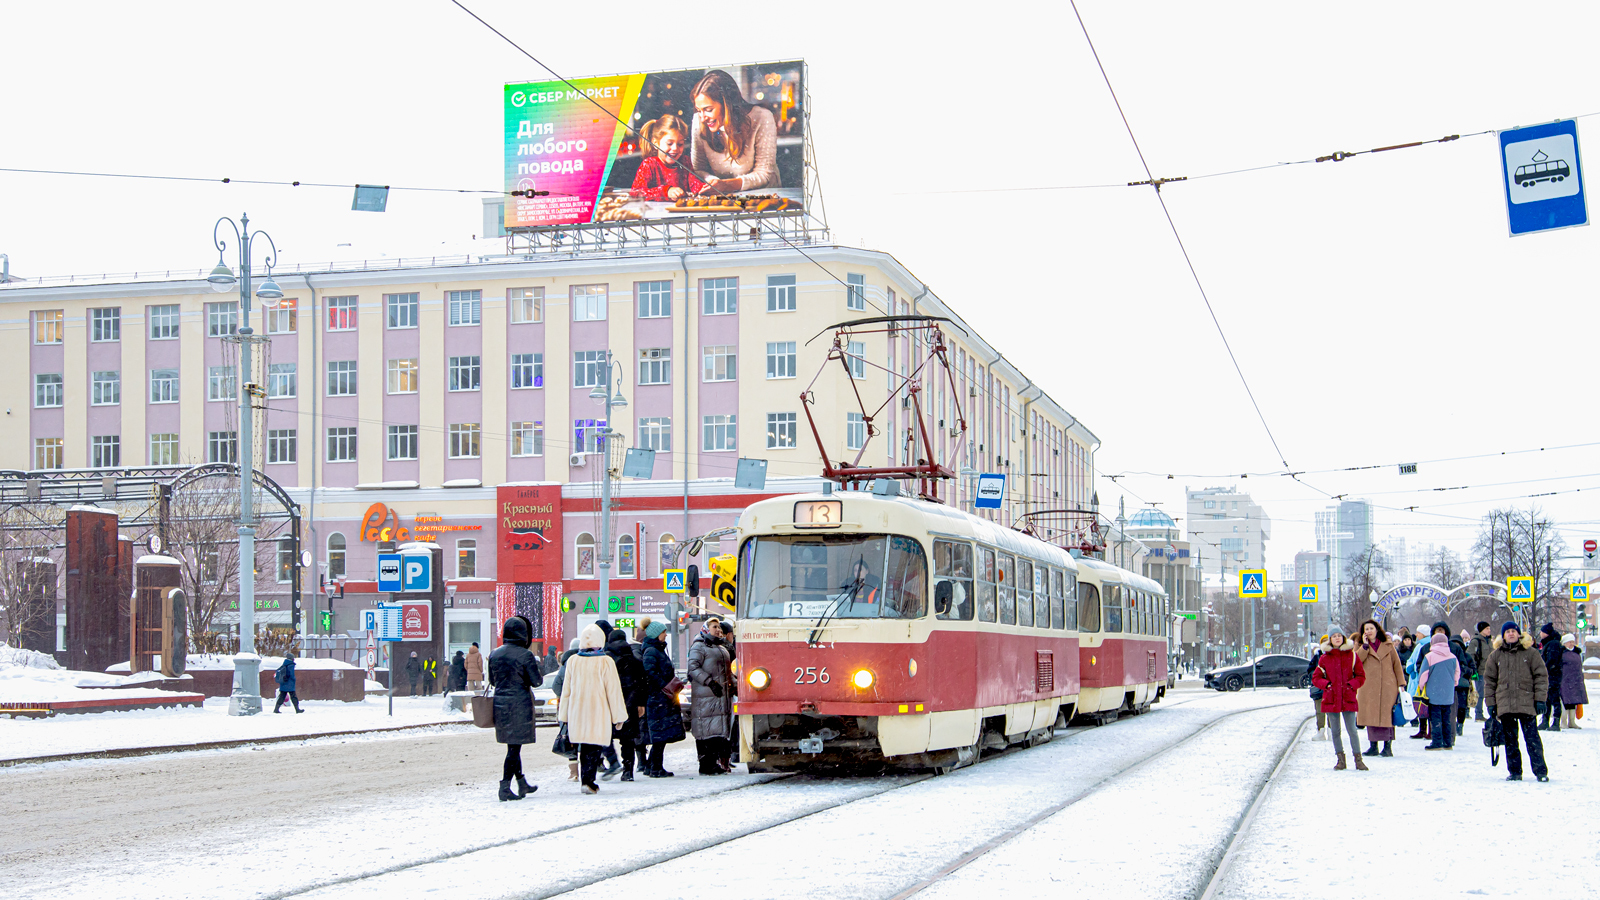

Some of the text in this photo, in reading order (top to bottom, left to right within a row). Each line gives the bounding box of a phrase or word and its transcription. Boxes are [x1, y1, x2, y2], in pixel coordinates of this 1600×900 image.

[529, 86, 620, 104] СБЕР МАРКЕТ
[517, 120, 554, 139] Для
[517, 137, 587, 156] любого
[518, 159, 584, 174] повода
[1400, 465, 1417, 473] 1188
[503, 502, 553, 517] Красный
[809, 504, 830, 526] 13
[414, 524, 483, 533] вегетарианское
[503, 517, 552, 531] Леопард
[414, 534, 437, 542] кафе
[406, 562, 423, 585] P
[229, 600, 280, 609] АЕКА
[788, 602, 804, 616] 13
[1374, 586, 1448, 623] АТЕРИНБУРГЗОО
[367, 614, 373, 628] P
[794, 666, 831, 684] 256
